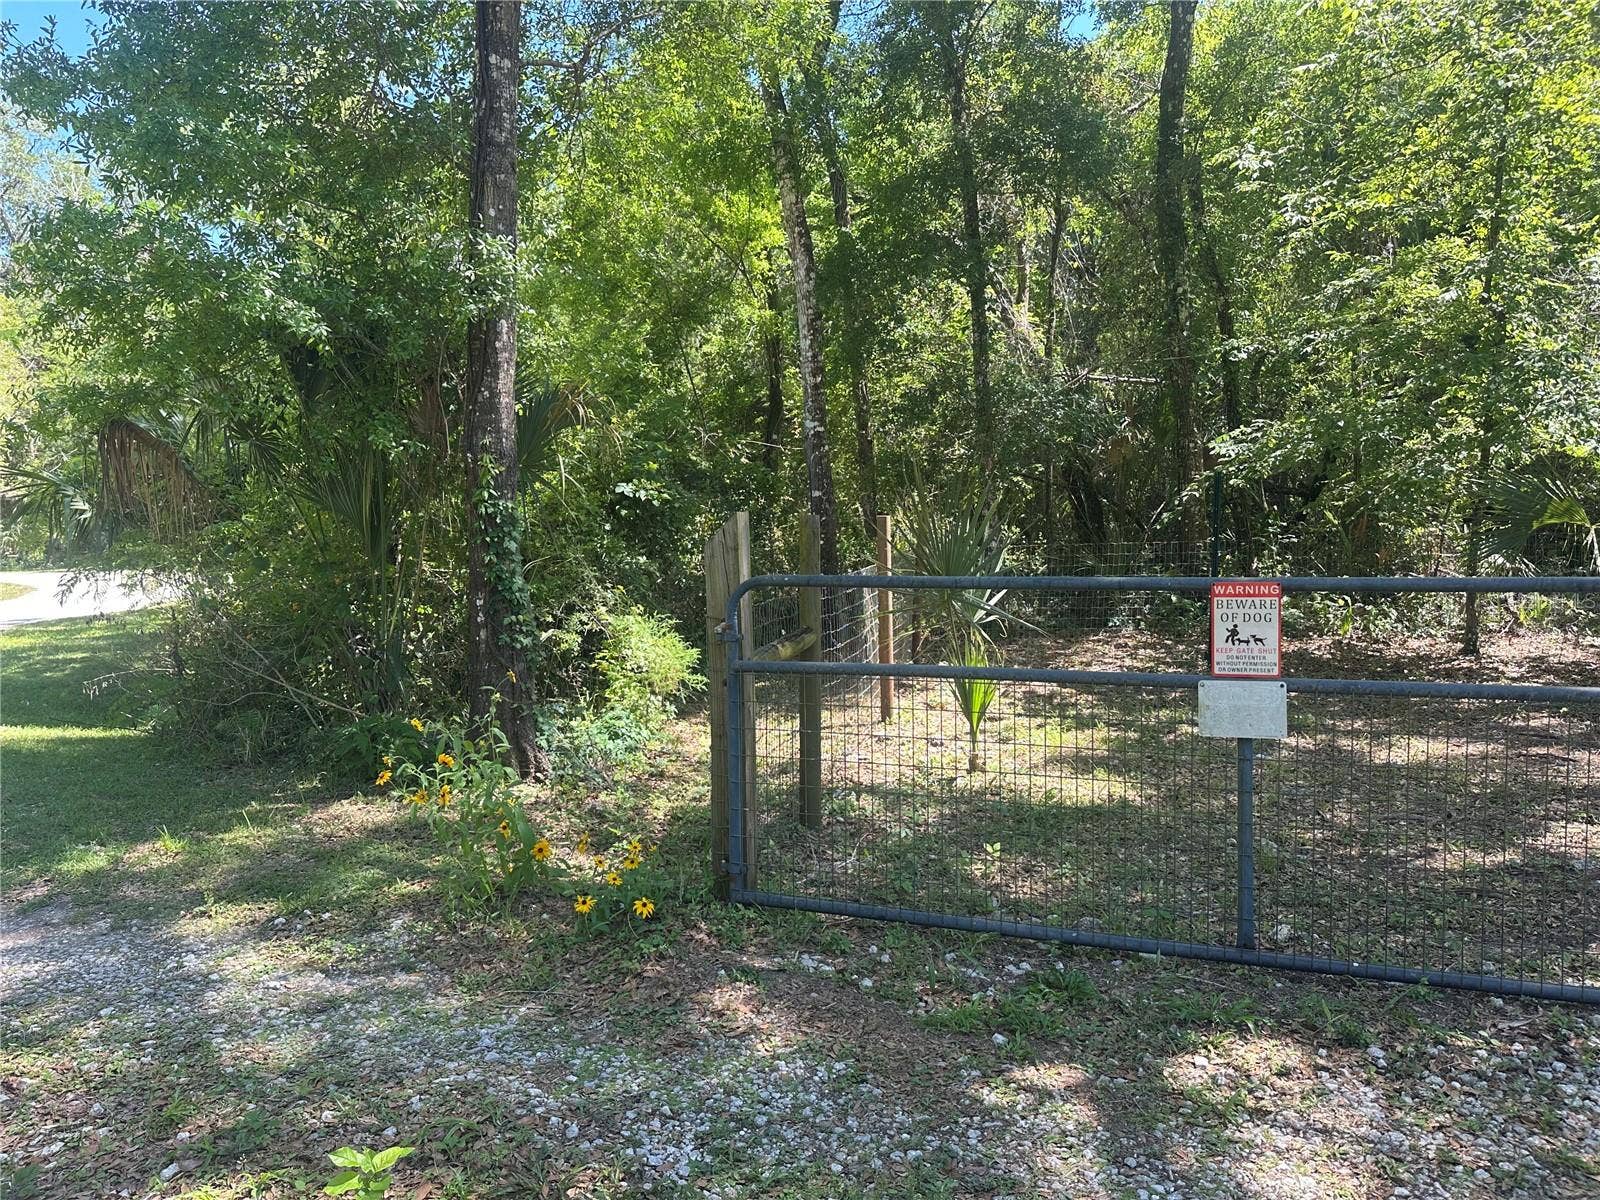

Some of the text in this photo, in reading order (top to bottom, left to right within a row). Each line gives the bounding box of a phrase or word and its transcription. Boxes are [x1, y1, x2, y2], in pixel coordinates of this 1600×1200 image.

[1214, 585, 1280, 594] WARNING
[1216, 599, 1277, 609] BEWARE
[1220, 612, 1272, 622] OF DOG
